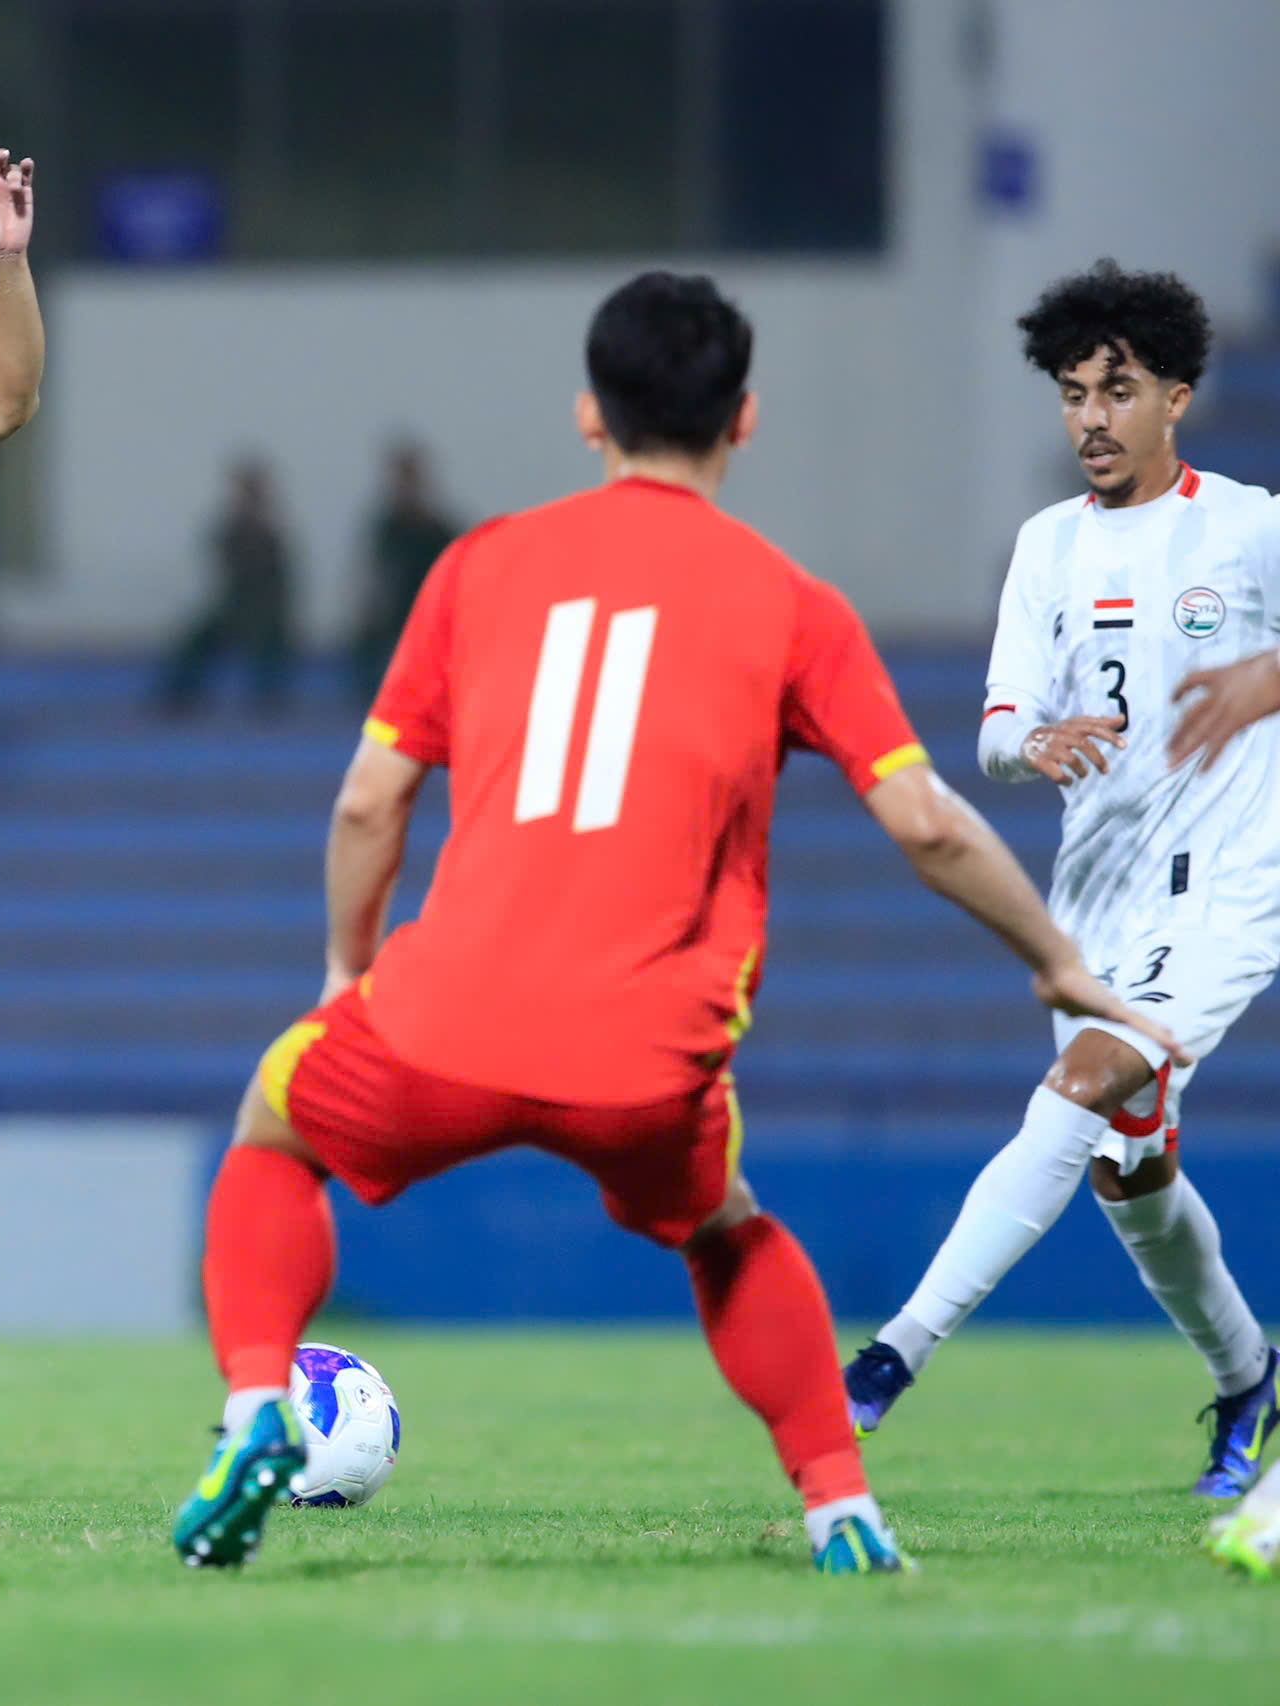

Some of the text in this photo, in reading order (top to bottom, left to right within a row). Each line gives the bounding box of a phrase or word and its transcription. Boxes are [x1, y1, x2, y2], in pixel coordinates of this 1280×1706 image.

[514, 596, 659, 834] 11
[1099, 660, 1128, 733] 3
[1126, 946, 1172, 988] 3
